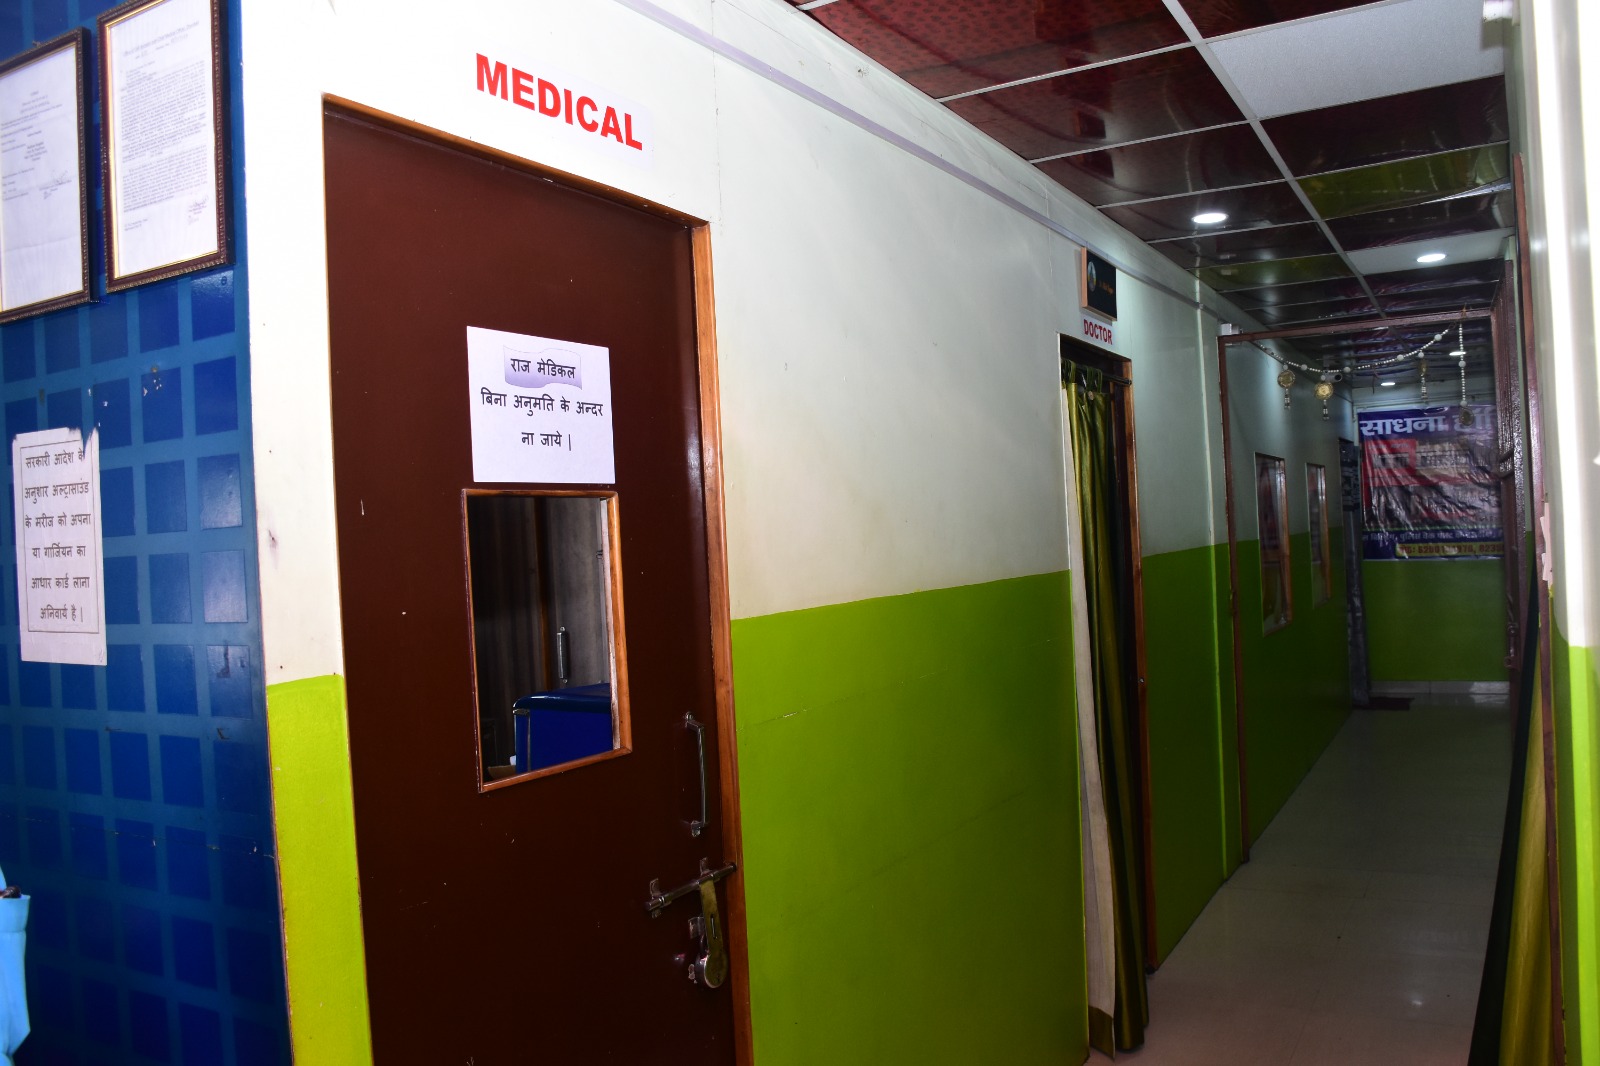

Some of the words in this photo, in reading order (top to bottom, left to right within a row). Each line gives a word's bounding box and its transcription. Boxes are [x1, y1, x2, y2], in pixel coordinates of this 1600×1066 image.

[476, 52, 642, 151] MEDICAL
[1083, 319, 1113, 345] DOCTOR
[510, 358, 531, 373] राज
[537, 357, 576, 379] मेडिकल
[480, 387, 507, 407] बिना
[513, 393, 555, 417] अनुमति
[560, 396, 571, 413] के
[575, 401, 604, 416] अन्दर
[1359, 415, 1447, 436] साधना
[521, 431, 535, 445] ना
[540, 430, 562, 447] जाये
[25, 450, 50, 468] सरकारी
[54, 449, 74, 466] आदेश
[25, 514, 32, 529] के
[35, 513, 54, 528] मरीज
[58, 511, 67, 527] को
[70, 512, 91, 526] अपना
[32, 546, 41, 558] या
[76, 544, 86, 557] का
[31, 576, 52, 590] आधार
[55, 572, 69, 589] कार्ड
[73, 576, 90, 589] लाना
[40, 604, 68, 620] अनिवार्य
[71, 603, 76, 621] है
